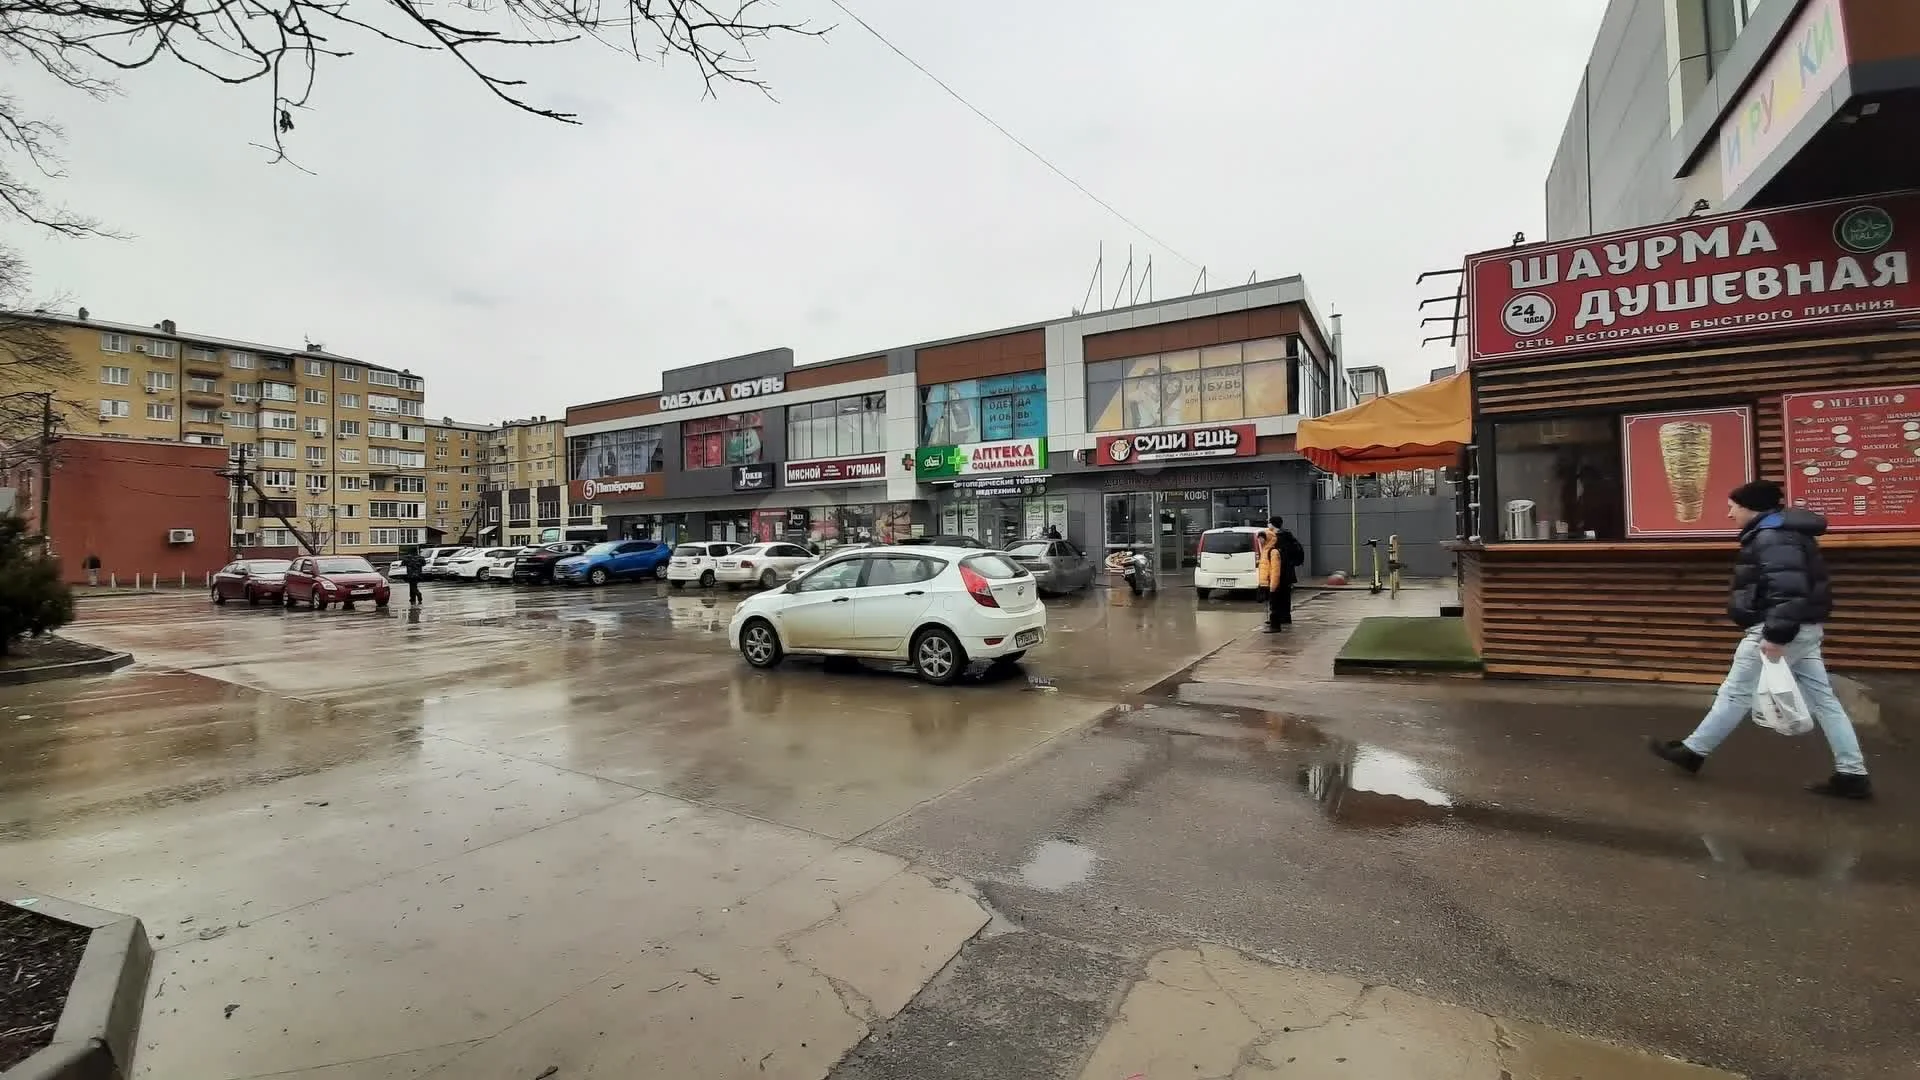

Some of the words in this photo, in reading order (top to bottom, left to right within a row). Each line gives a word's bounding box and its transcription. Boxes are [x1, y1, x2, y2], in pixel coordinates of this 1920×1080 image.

[1510, 220, 1777, 289] ШАУРМА
[1574, 251, 1910, 329] ДУШЕВНАЯ
[1511, 303, 1536, 317] 24
[1515, 338, 1555, 350] СЕТЬ
[1565, 321, 1680, 344] РЕСТОРАНОВ
[1690, 309, 1793, 328] БЫСТРОГО
[1804, 299, 1895, 316] ПИТАНИЯ
[1523, 315, 1545, 324] ЧАСА
[660, 387, 726, 410] ОДЕЖДА
[730, 377, 785, 399] ОБУВЬ
[989, 398, 1031, 409] ОДЕДА
[1134, 432, 1186, 451] СУШИ
[1193, 428, 1238, 447] ЕШЬ
[972, 444, 1034, 460] АПТЕКА
[971, 458, 1034, 470] СОЦИАЛЬНАЯ
[788, 465, 821, 481] МЯСНОЙ
[846, 463, 881, 476] ГУРМАН
[953, 480, 1014, 489] ОРТОПЕДИЧЕСКИЕ
[1015, 477, 1046, 485] ТОВАРЫ
[975, 487, 1021, 496] МЕДТЕХНИКА
[1155, 491, 1169, 502] ТУТ
[1184, 490, 1209, 501] КОФЕ!
